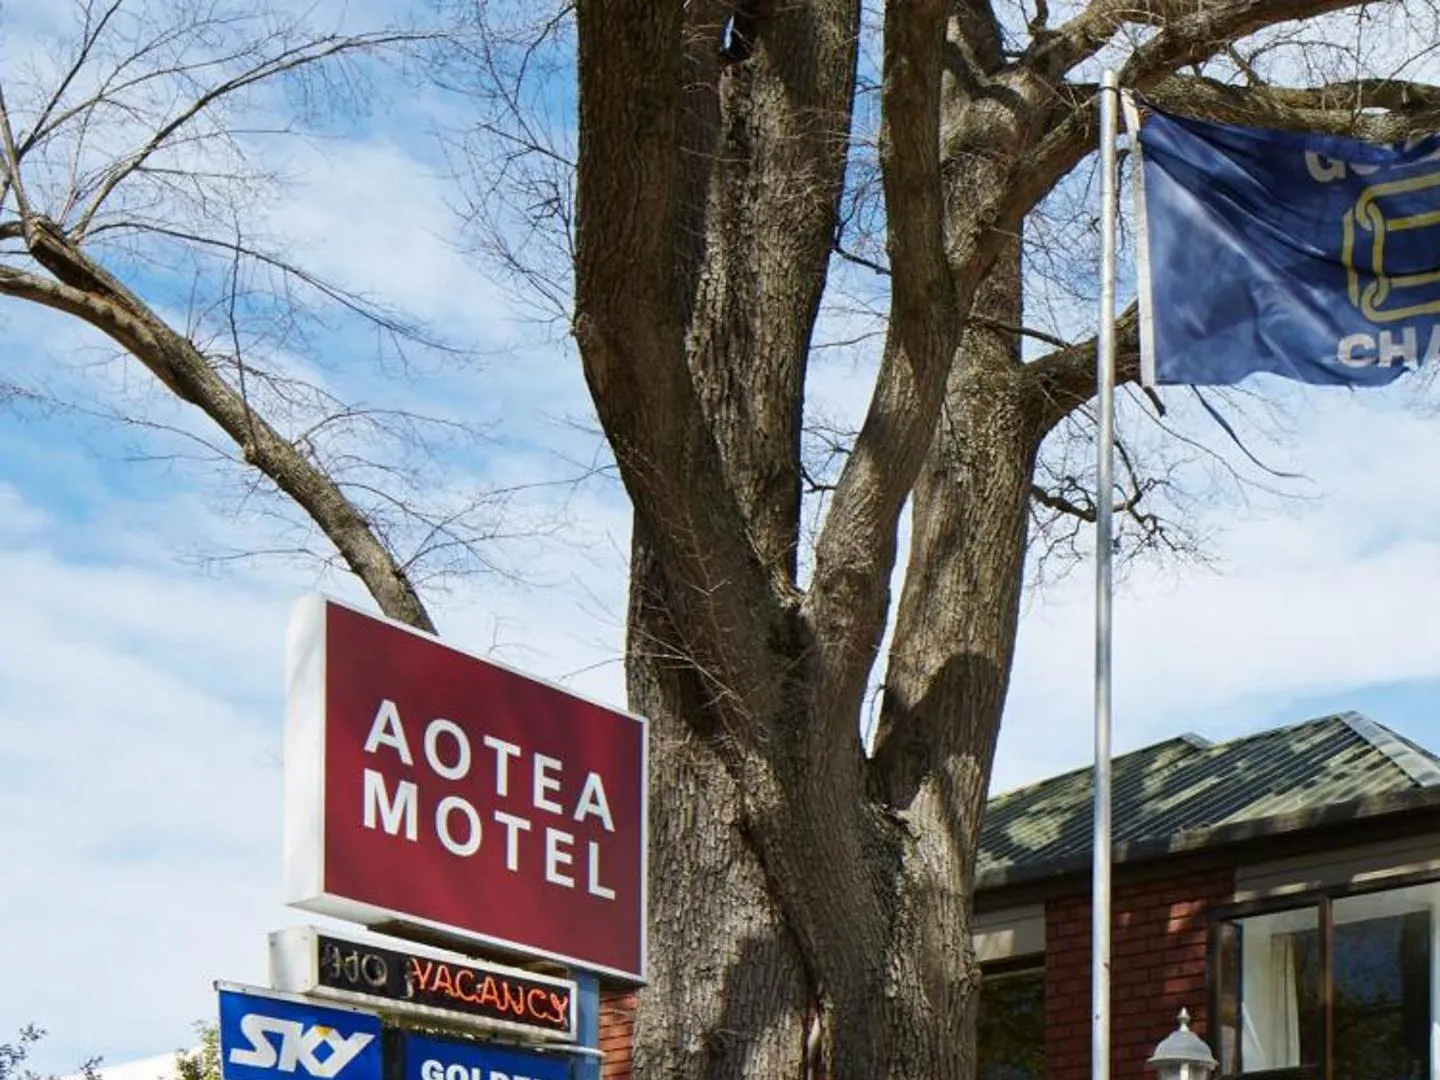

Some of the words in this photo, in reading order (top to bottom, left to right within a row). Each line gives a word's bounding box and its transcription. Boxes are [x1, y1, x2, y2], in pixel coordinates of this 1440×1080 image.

[363, 699, 615, 832] AOTEA
[363, 768, 616, 900] MOTEL
[411, 957, 569, 1023] VACANCY
[228, 1013, 376, 1078] SKY
